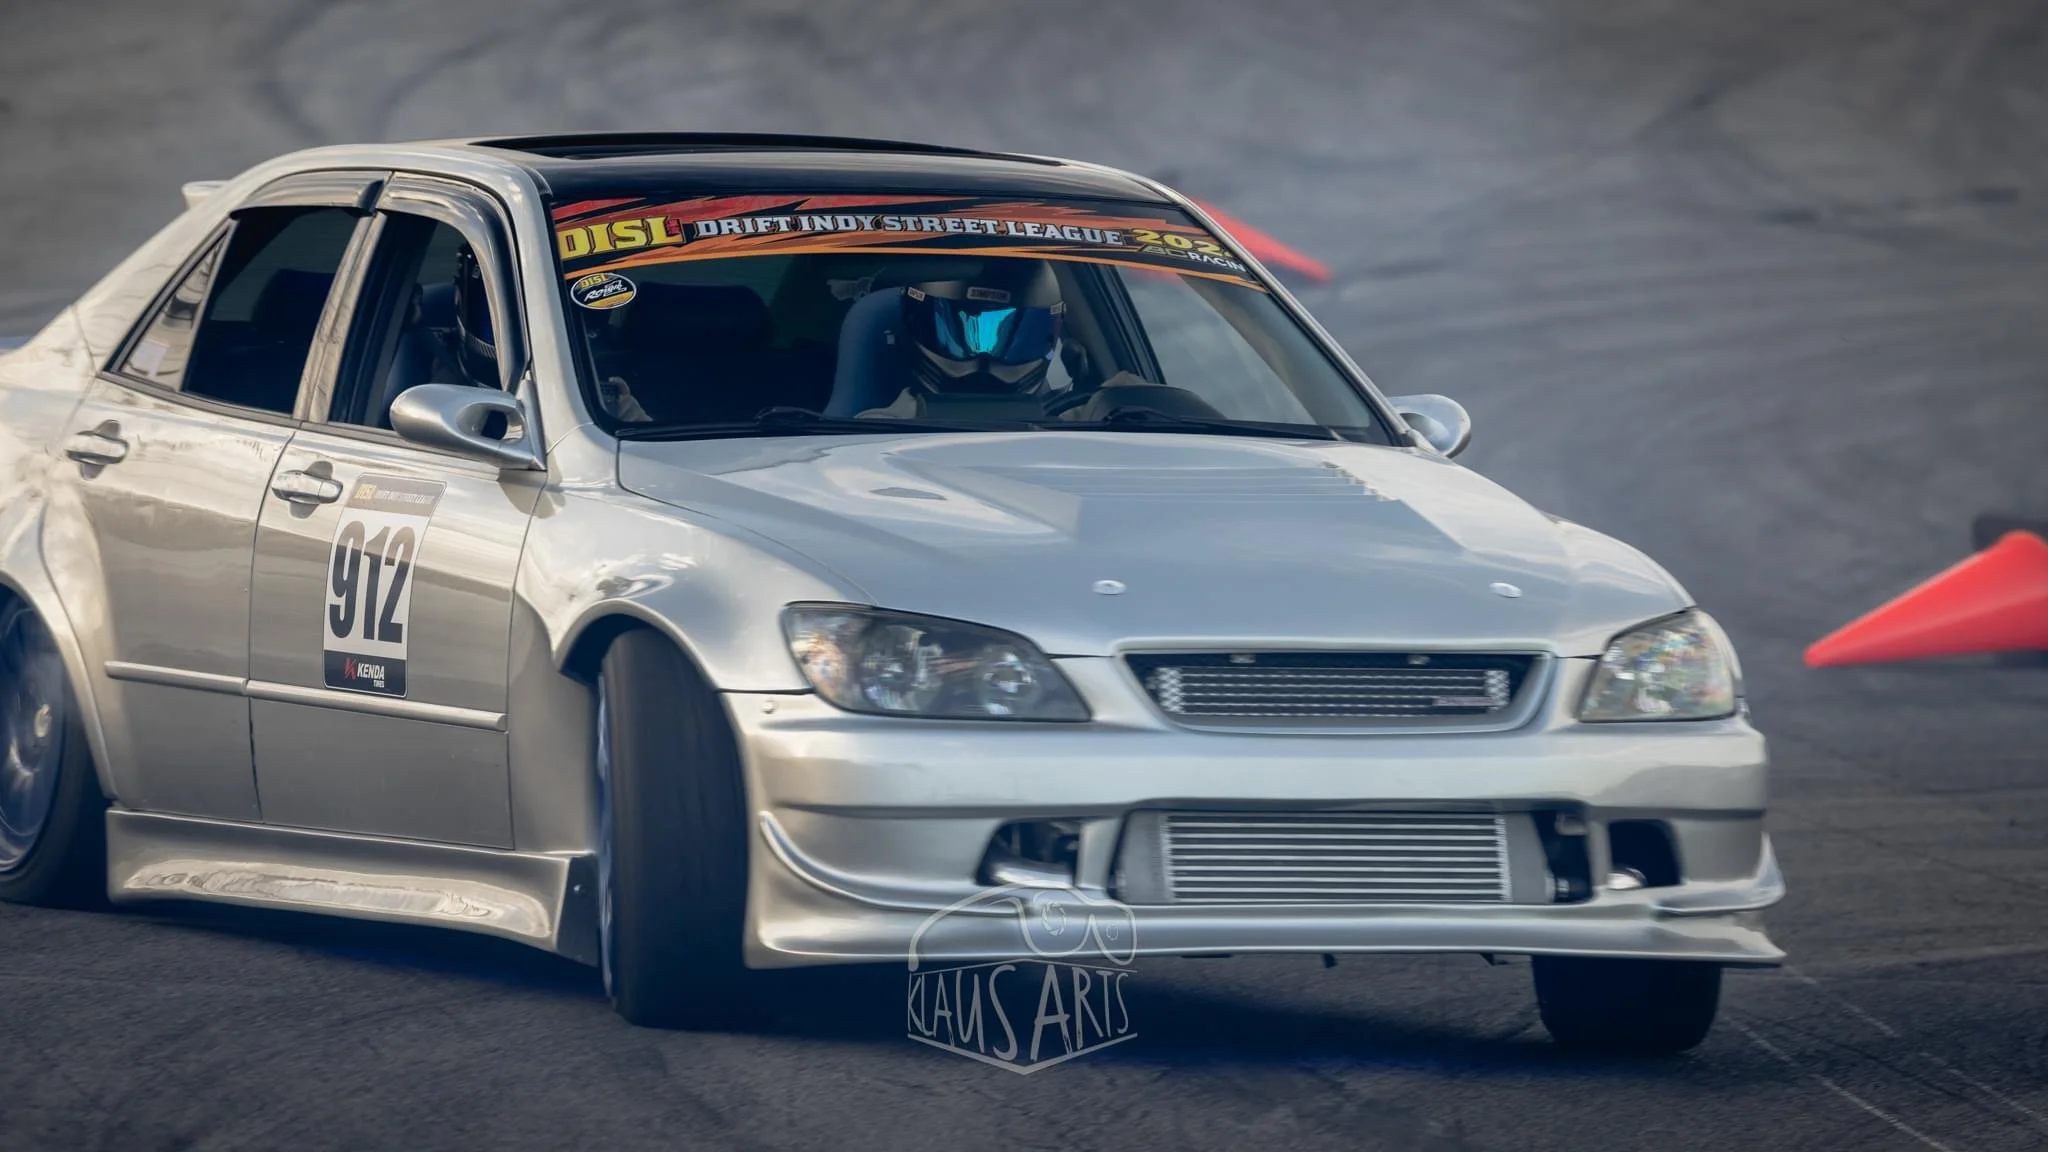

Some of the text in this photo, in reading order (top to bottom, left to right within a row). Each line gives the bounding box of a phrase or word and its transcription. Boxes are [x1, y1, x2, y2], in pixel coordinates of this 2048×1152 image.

[556, 215, 1233, 259] DISL DRIFT INDY STREET LEAGUE 202
[1187, 252, 1246, 272] RACIN
[329, 520, 415, 643] 912
[357, 663, 385, 680] KENDA
